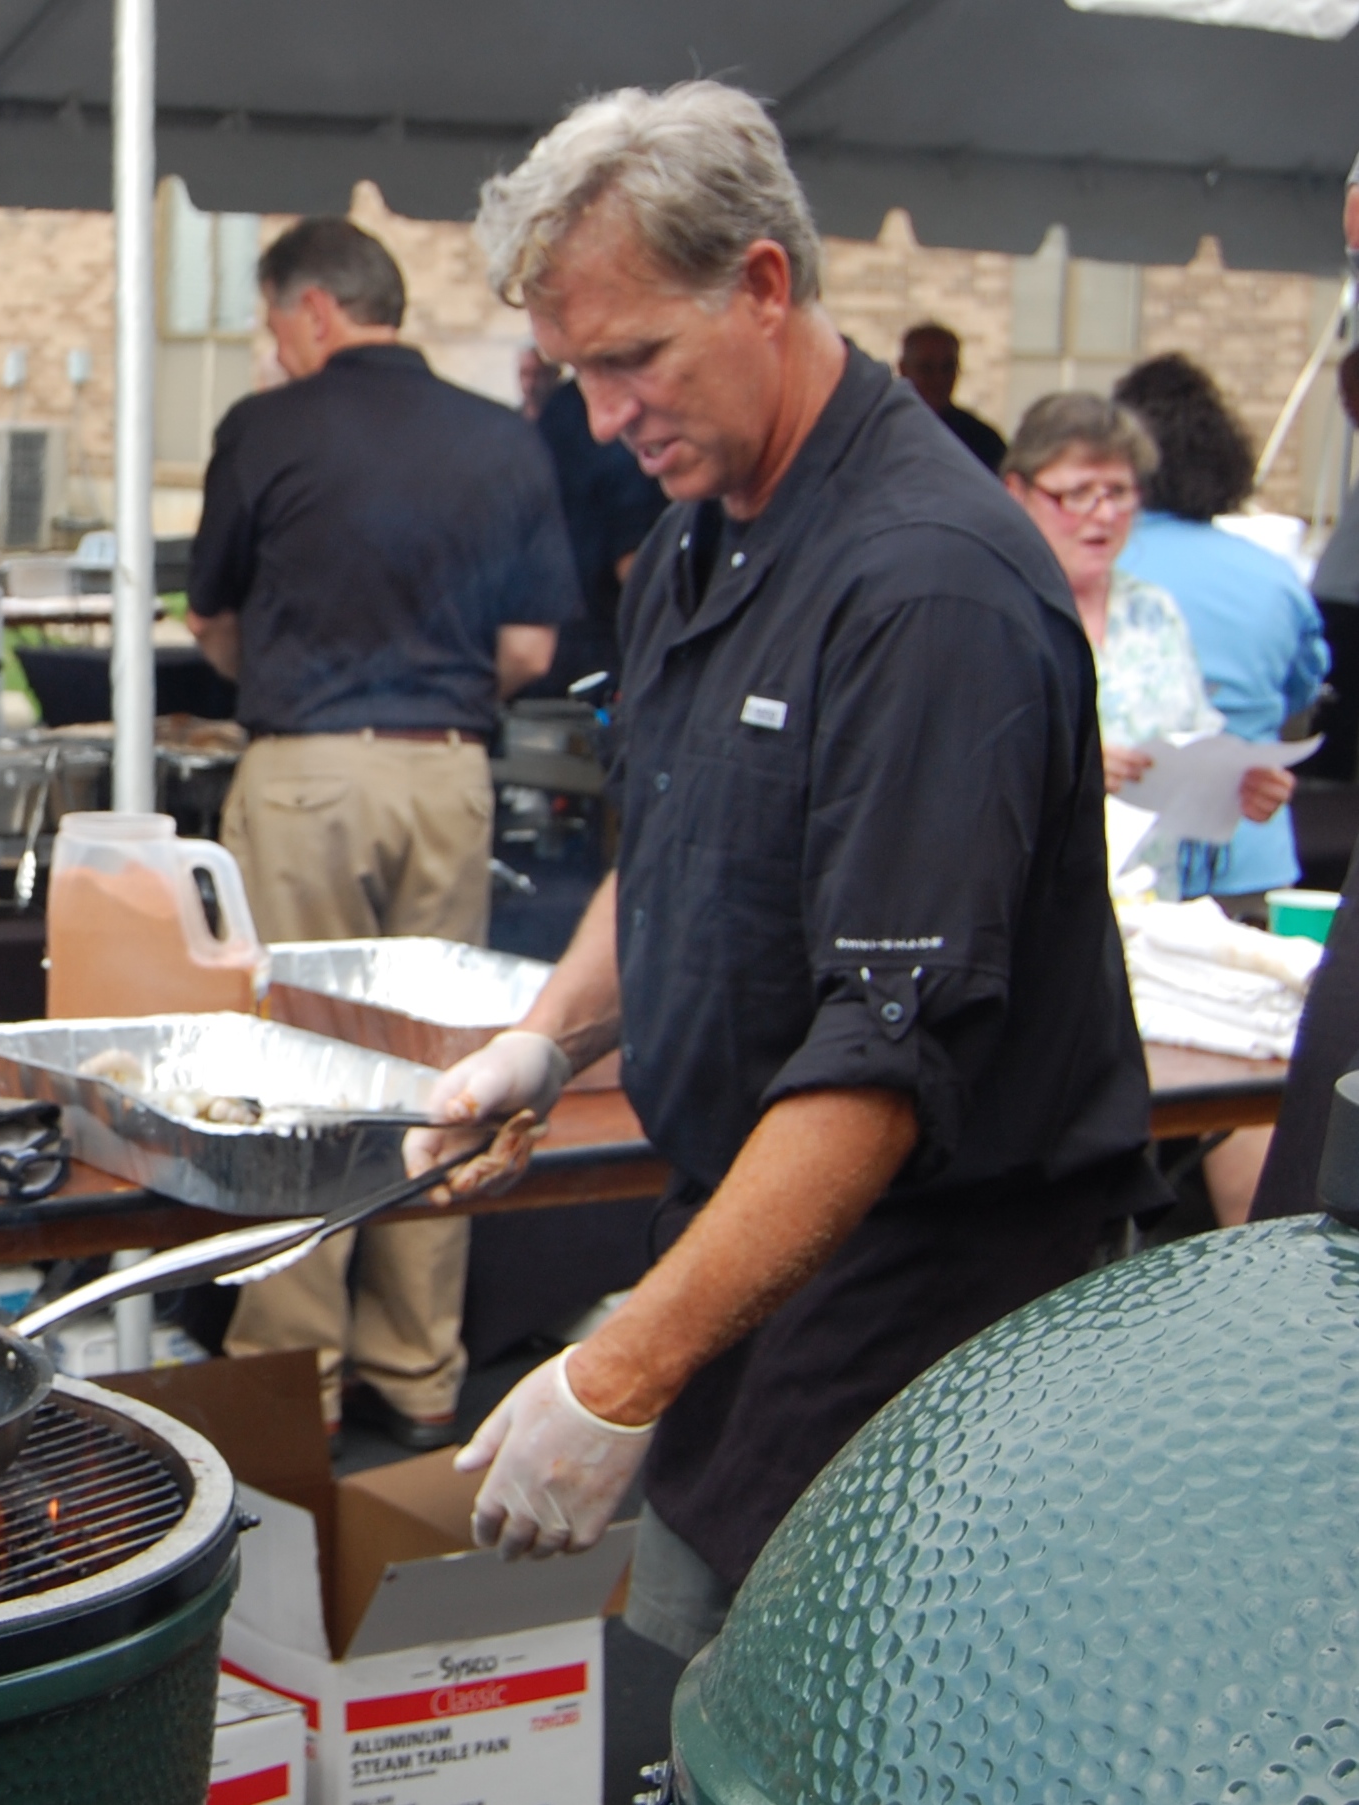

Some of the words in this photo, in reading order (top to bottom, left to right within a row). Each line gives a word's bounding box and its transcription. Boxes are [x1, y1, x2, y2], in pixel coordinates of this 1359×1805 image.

[440, 1656, 499, 1682] Sysco
[430, 1681, 508, 1717] Classic
[351, 1726, 452, 1756] ALUMINUM
[351, 1753, 413, 1778] STEAM
[418, 1743, 470, 1766] TABLE
[474, 1737, 511, 1756] PAN
